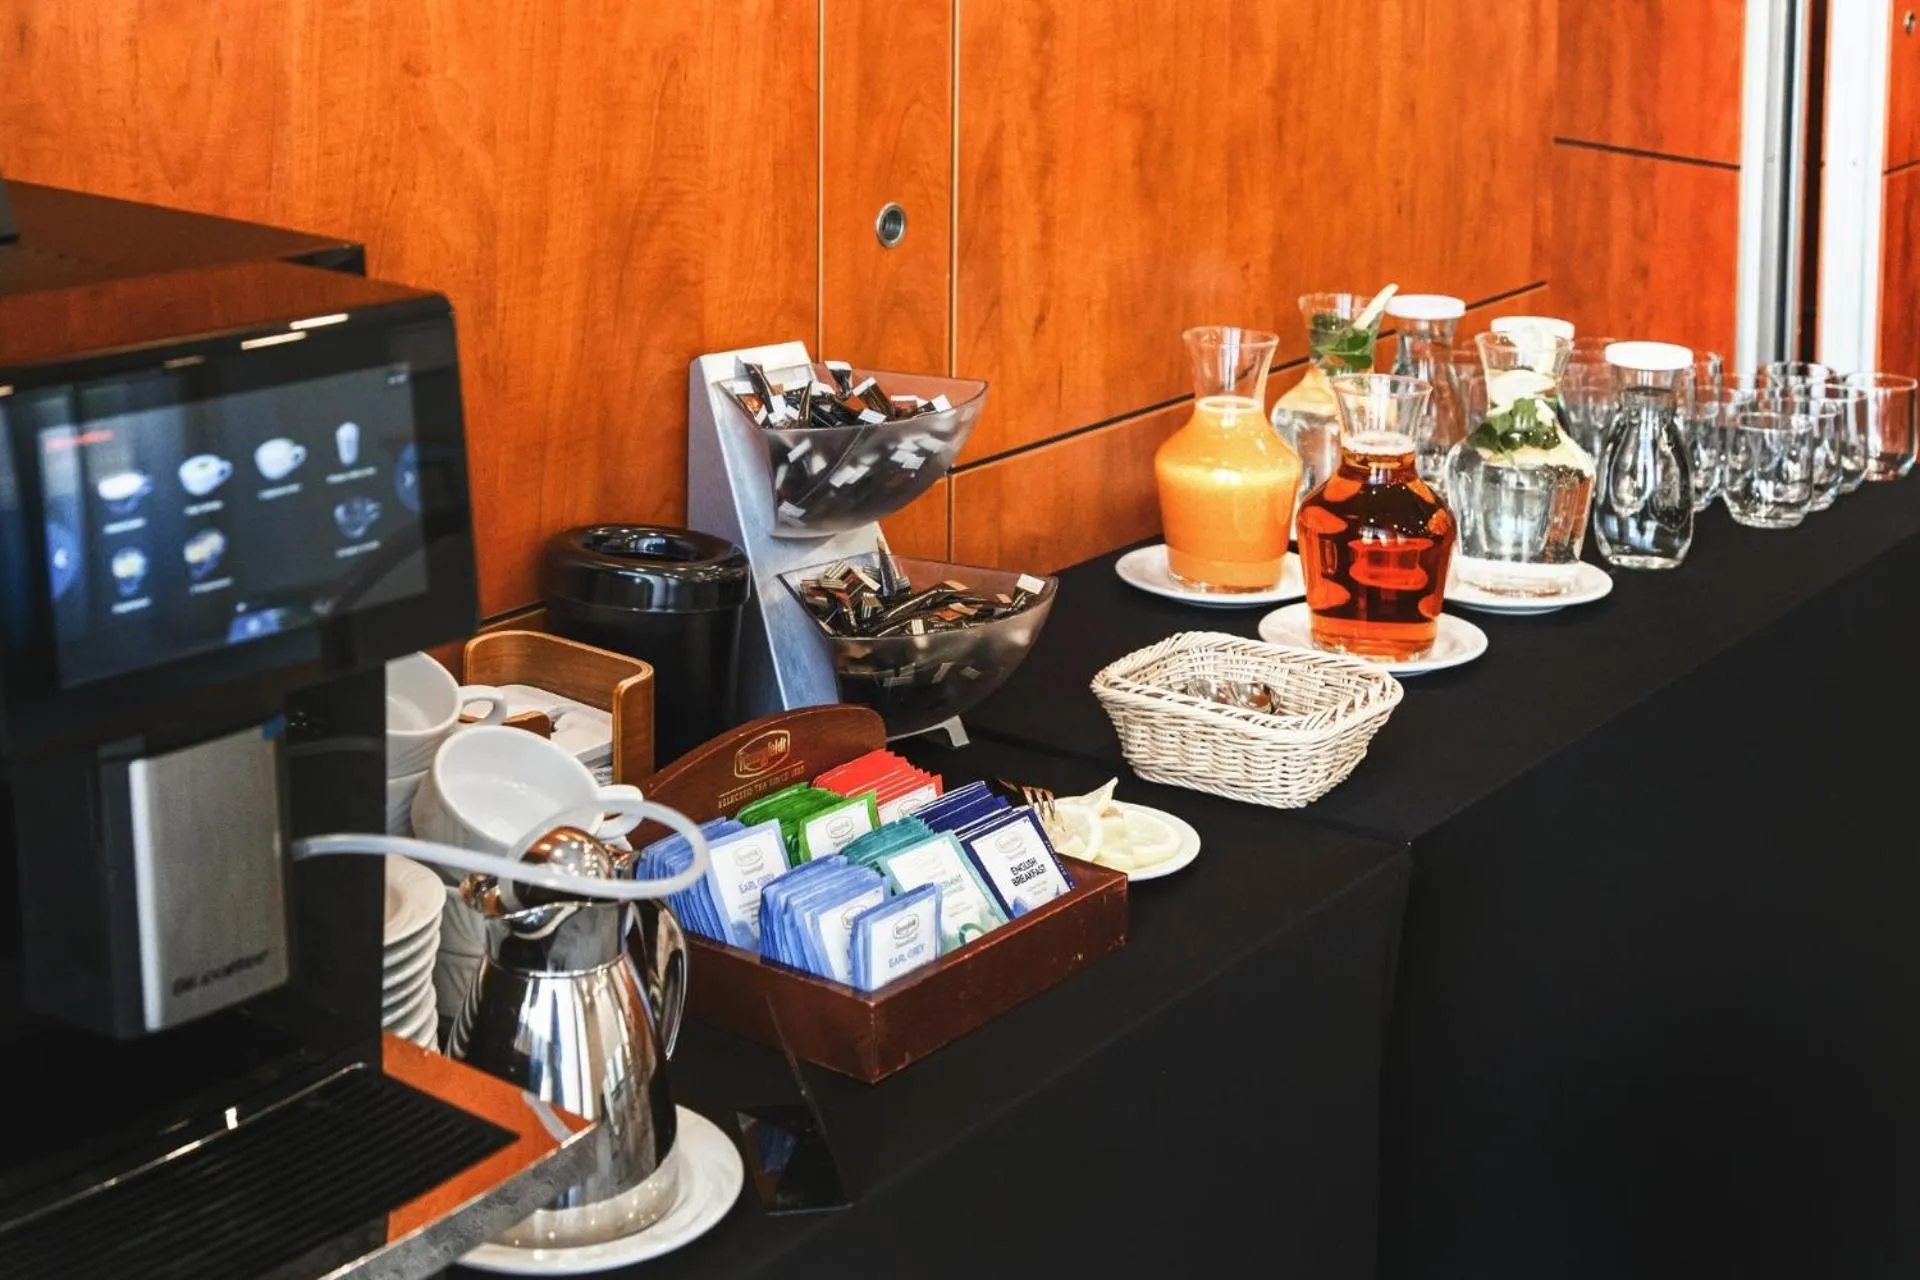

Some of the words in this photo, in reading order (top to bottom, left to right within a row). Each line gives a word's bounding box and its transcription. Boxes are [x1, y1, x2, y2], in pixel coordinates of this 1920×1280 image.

[1010, 857, 1038, 876] ENGLISH
[1011, 863, 1048, 887] BREAKFAST
[738, 878, 757, 894] EARL
[888, 953, 907, 968] EARL
